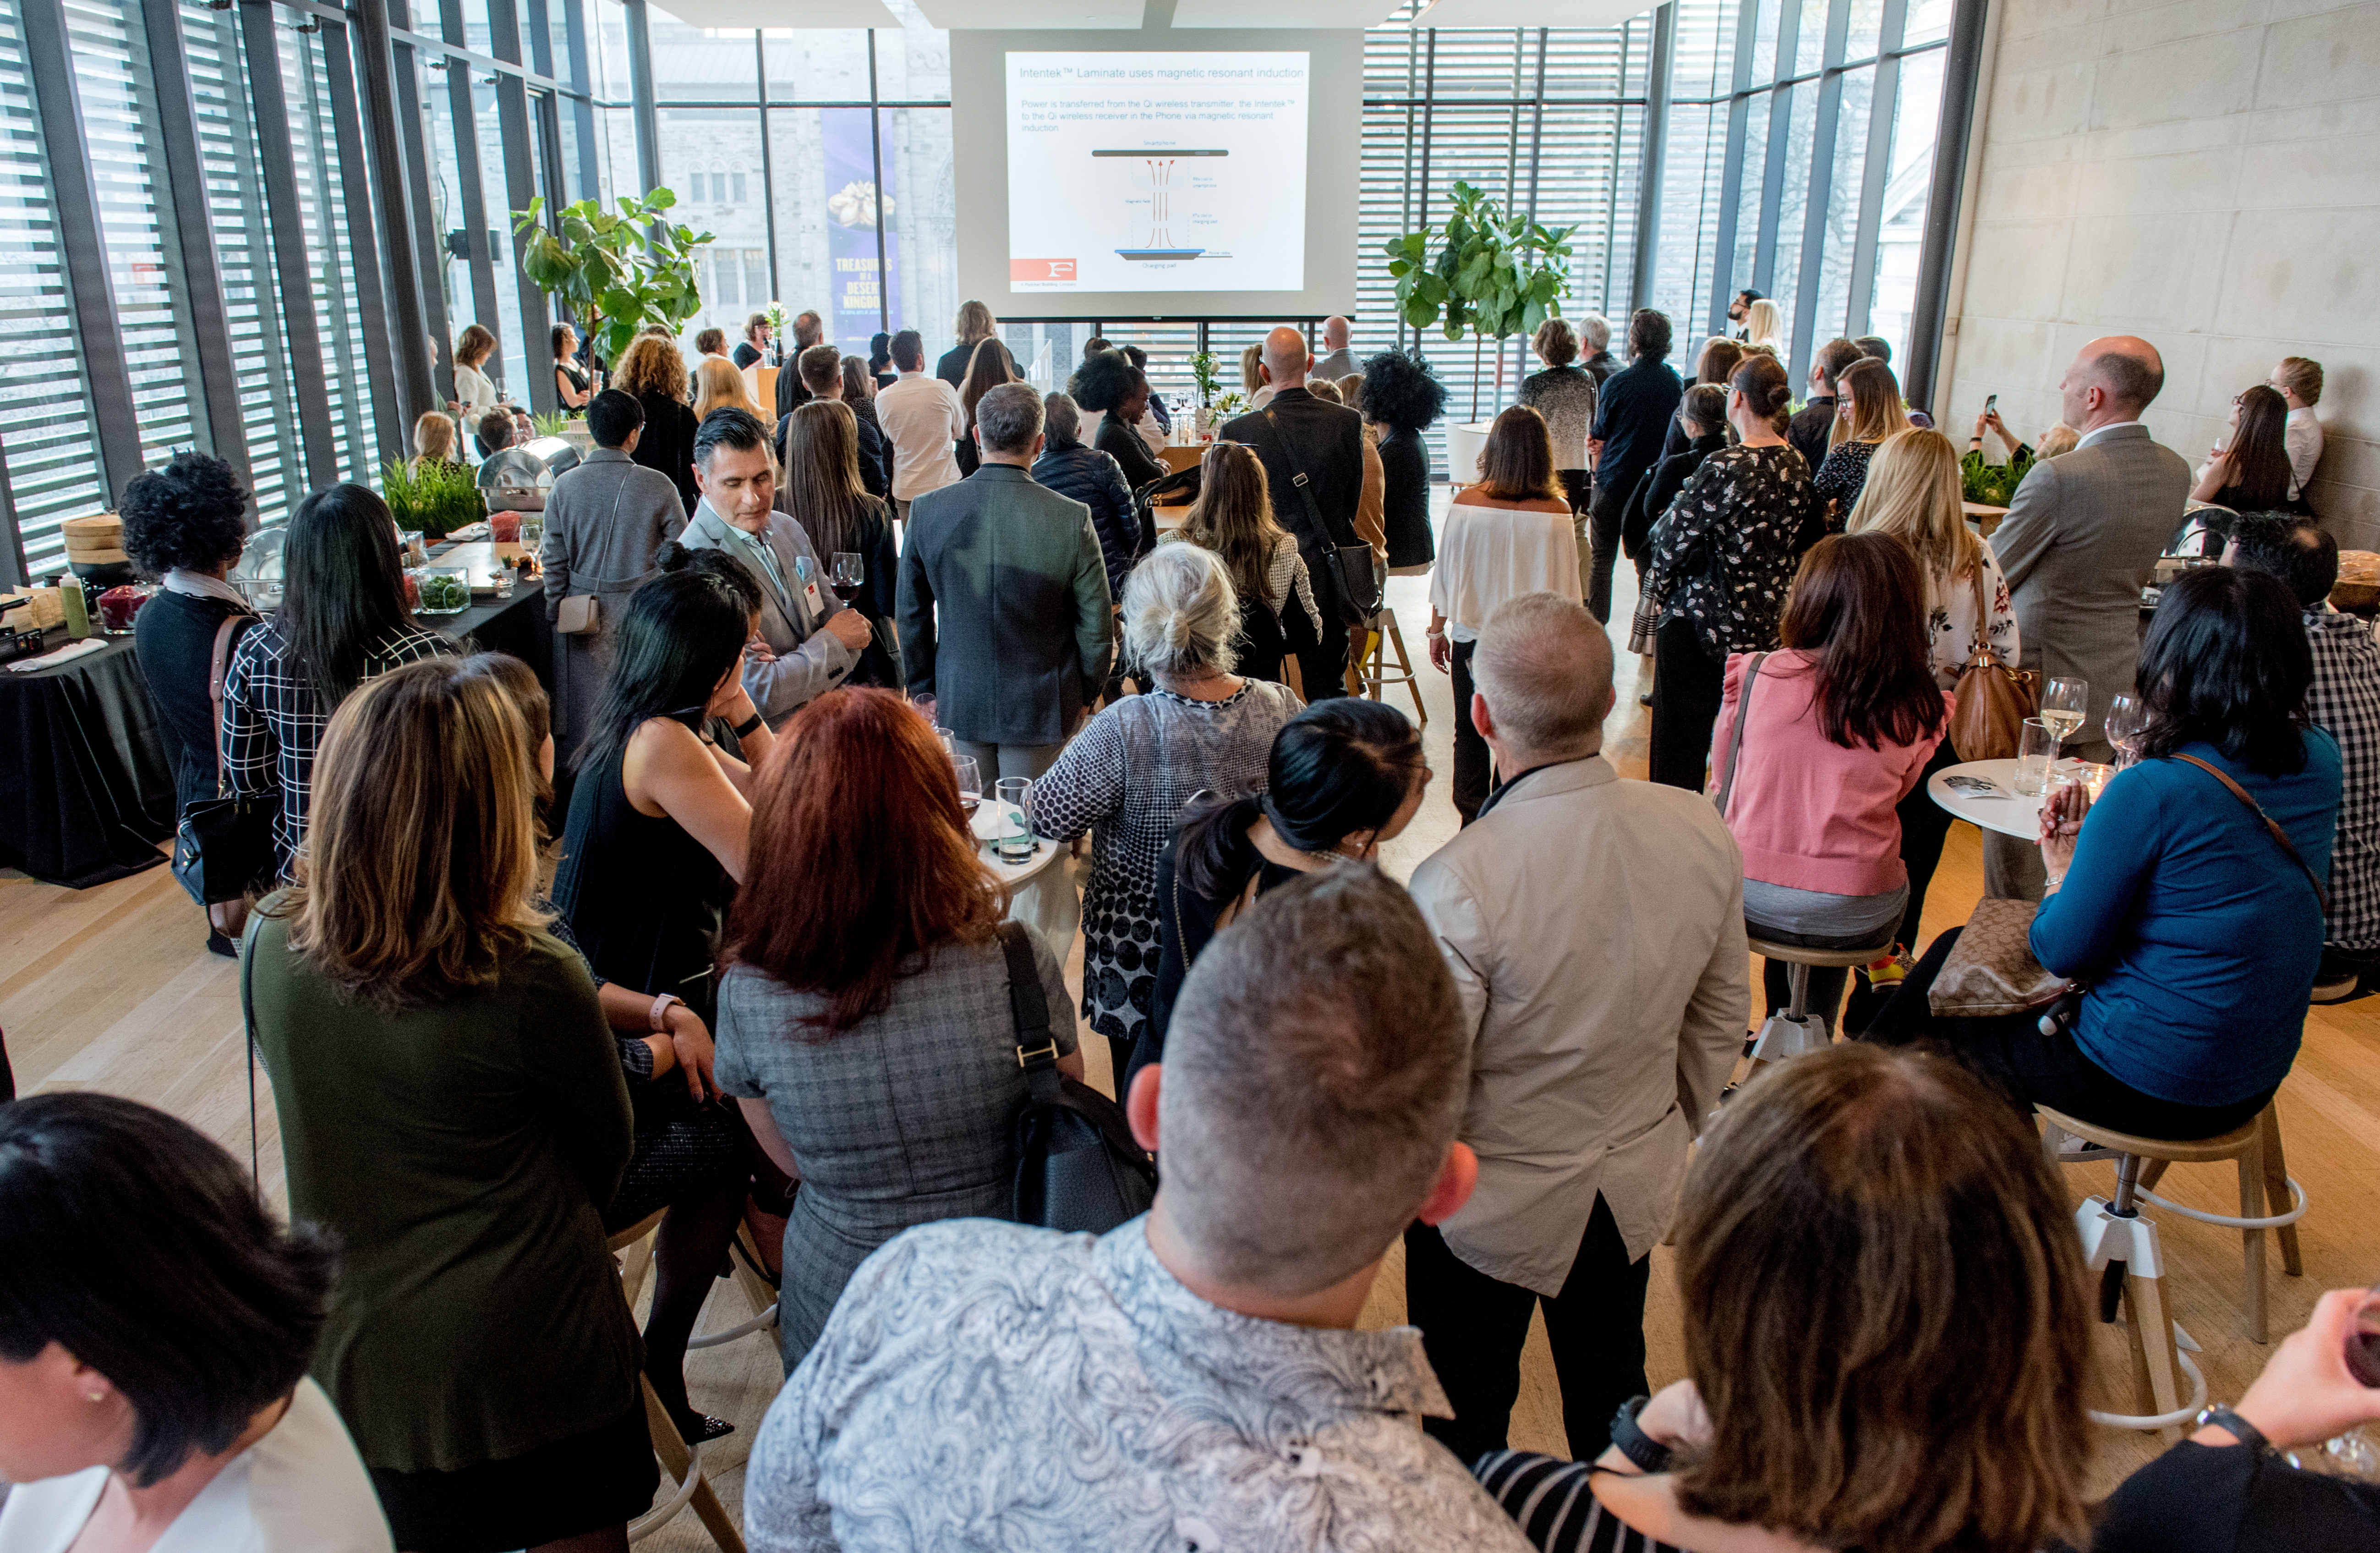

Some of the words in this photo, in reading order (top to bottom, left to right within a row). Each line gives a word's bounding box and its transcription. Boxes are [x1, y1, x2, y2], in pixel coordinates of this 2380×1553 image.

[1078, 67, 1126, 78] Laminate
[1129, 70, 1154, 78] uses
[1157, 68, 1205, 80] magnetic
[1208, 68, 1253, 78] resonant
[1257, 67, 1304, 78] induction
[1021, 100, 1048, 108] Power
[1050, 100, 1057, 108] is
[1060, 100, 1105, 108] transferred
[1107, 100, 1126, 108] from
[1128, 100, 1141, 108] the
[1143, 99, 1153, 108] Qi
[1155, 100, 1188, 108] wireless
[1191, 100, 1237, 109] transmitter,
[1048, 112, 1057, 120] Qi
[1155, 111, 1182, 120] Phone
[1198, 112, 1236, 122] magnetic
[1022, 124, 1059, 132] induction
[836, 258, 893, 271] TREASURS
[843, 296, 881, 309] KINGDO
